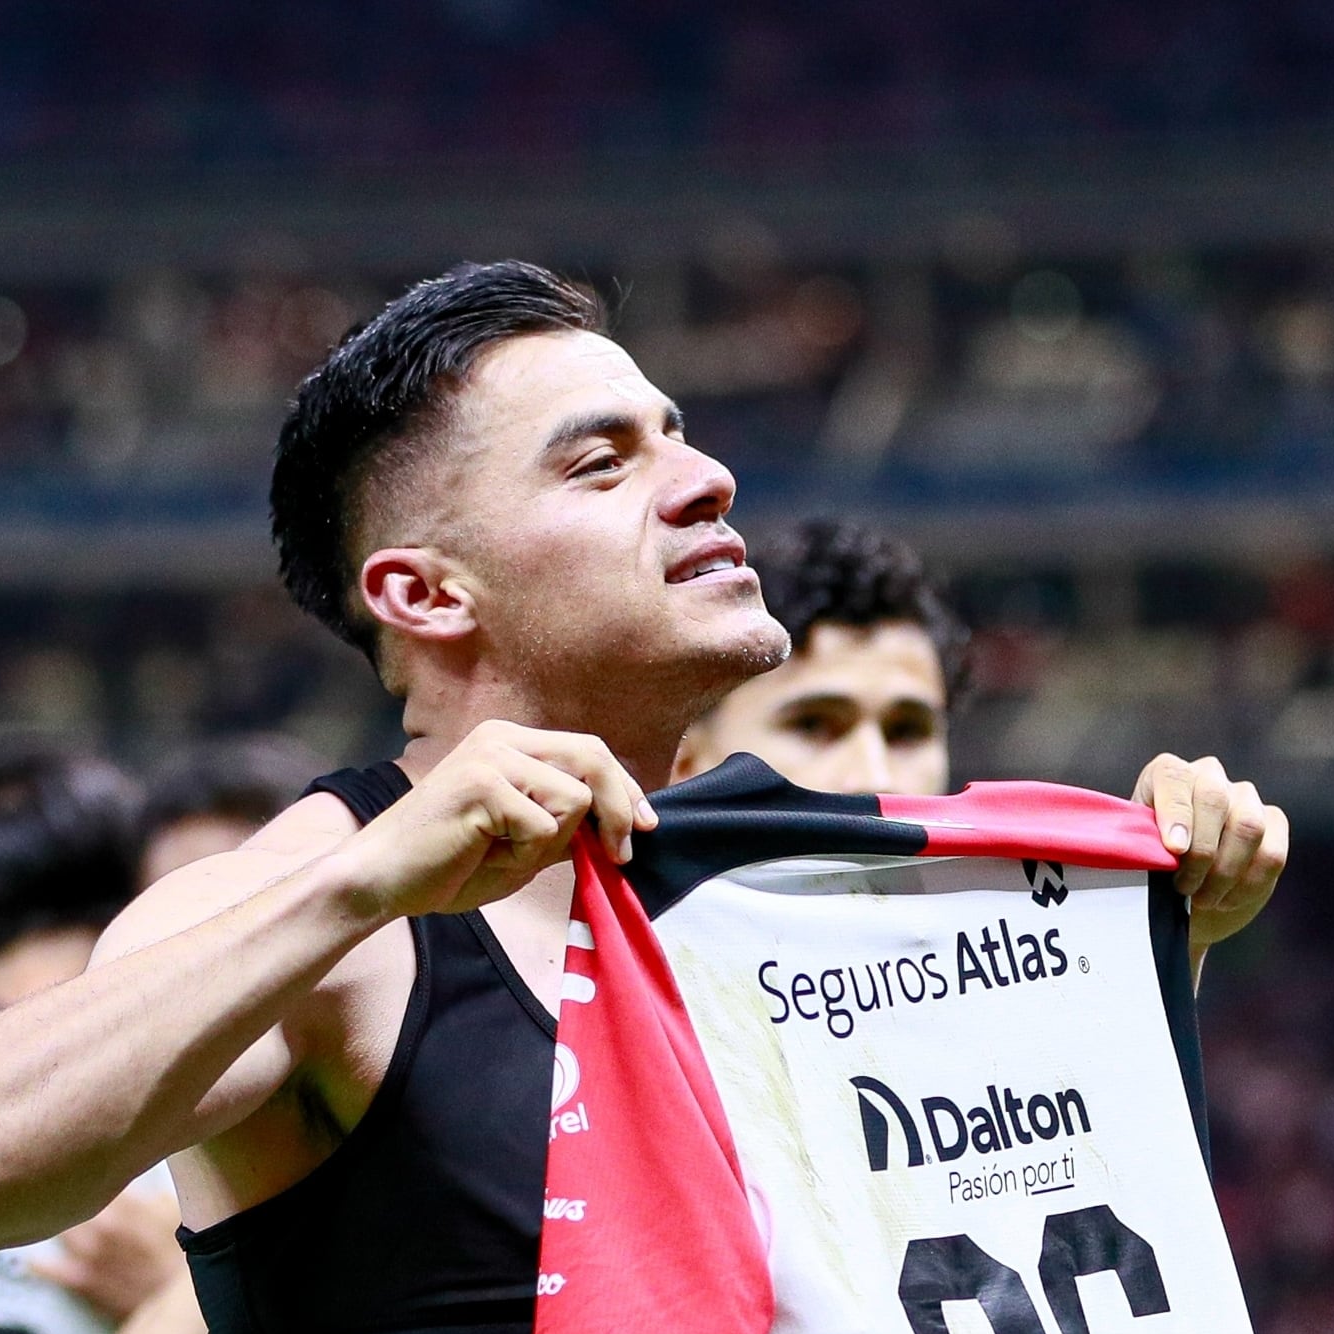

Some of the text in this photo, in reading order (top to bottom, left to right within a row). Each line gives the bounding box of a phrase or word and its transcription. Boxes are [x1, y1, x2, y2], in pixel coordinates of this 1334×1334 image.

[758, 919, 1068, 1038] Seguros Atlas
[920, 1086, 1091, 1163] Dalton
[949, 1148, 1076, 1204] Pasión por ti
